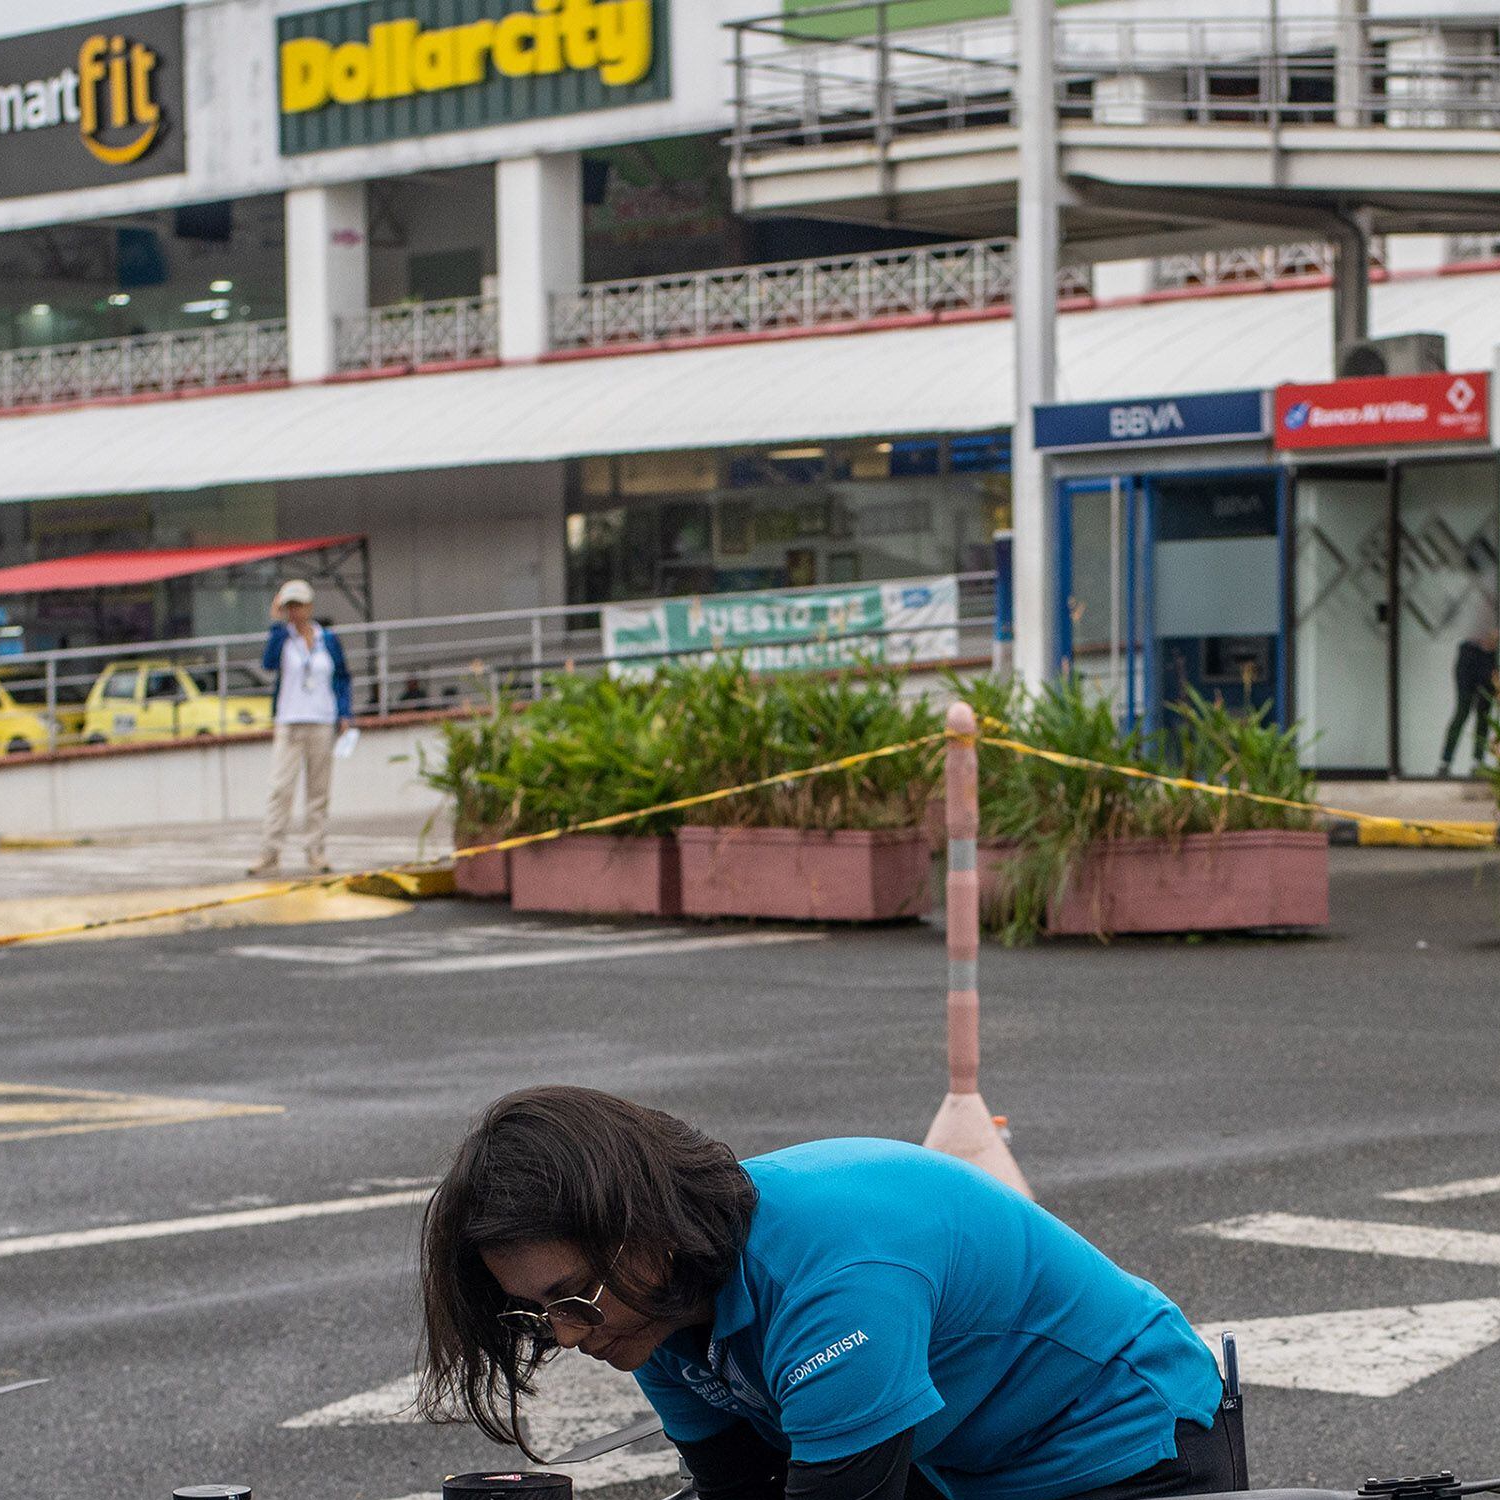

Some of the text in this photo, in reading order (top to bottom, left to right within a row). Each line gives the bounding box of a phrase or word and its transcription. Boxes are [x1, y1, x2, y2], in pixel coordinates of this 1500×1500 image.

[281, 0, 653, 114] Dollarcity
[1109, 401, 1185, 438] BBVA
[687, 604, 811, 637] PUESTO
[787, 1329, 869, 1385] CONTRATISTA
